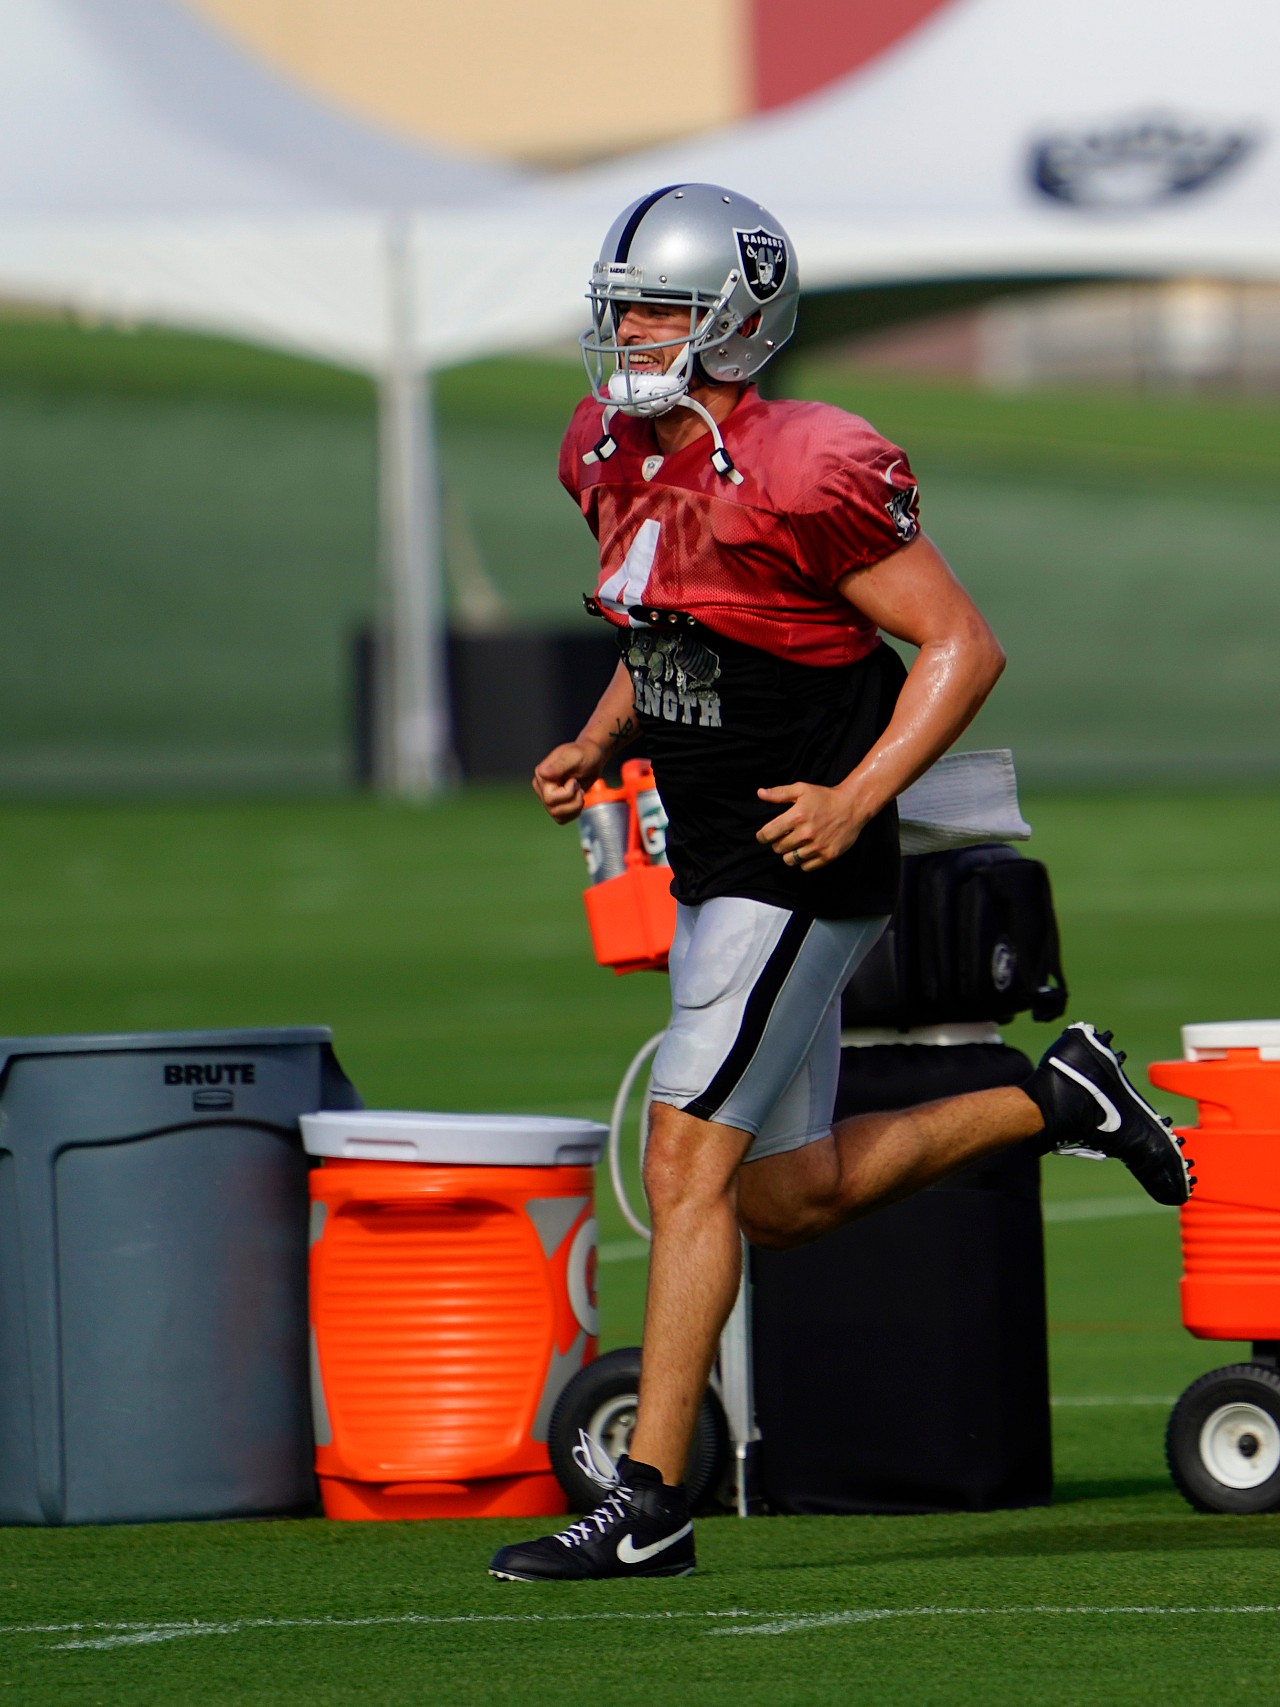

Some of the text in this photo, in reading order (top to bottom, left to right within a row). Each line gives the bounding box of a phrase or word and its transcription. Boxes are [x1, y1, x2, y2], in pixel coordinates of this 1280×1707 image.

[742, 234, 783, 248] RAIDERS
[598, 518, 661, 629] 4
[164, 1064, 255, 1086] BRUTE
